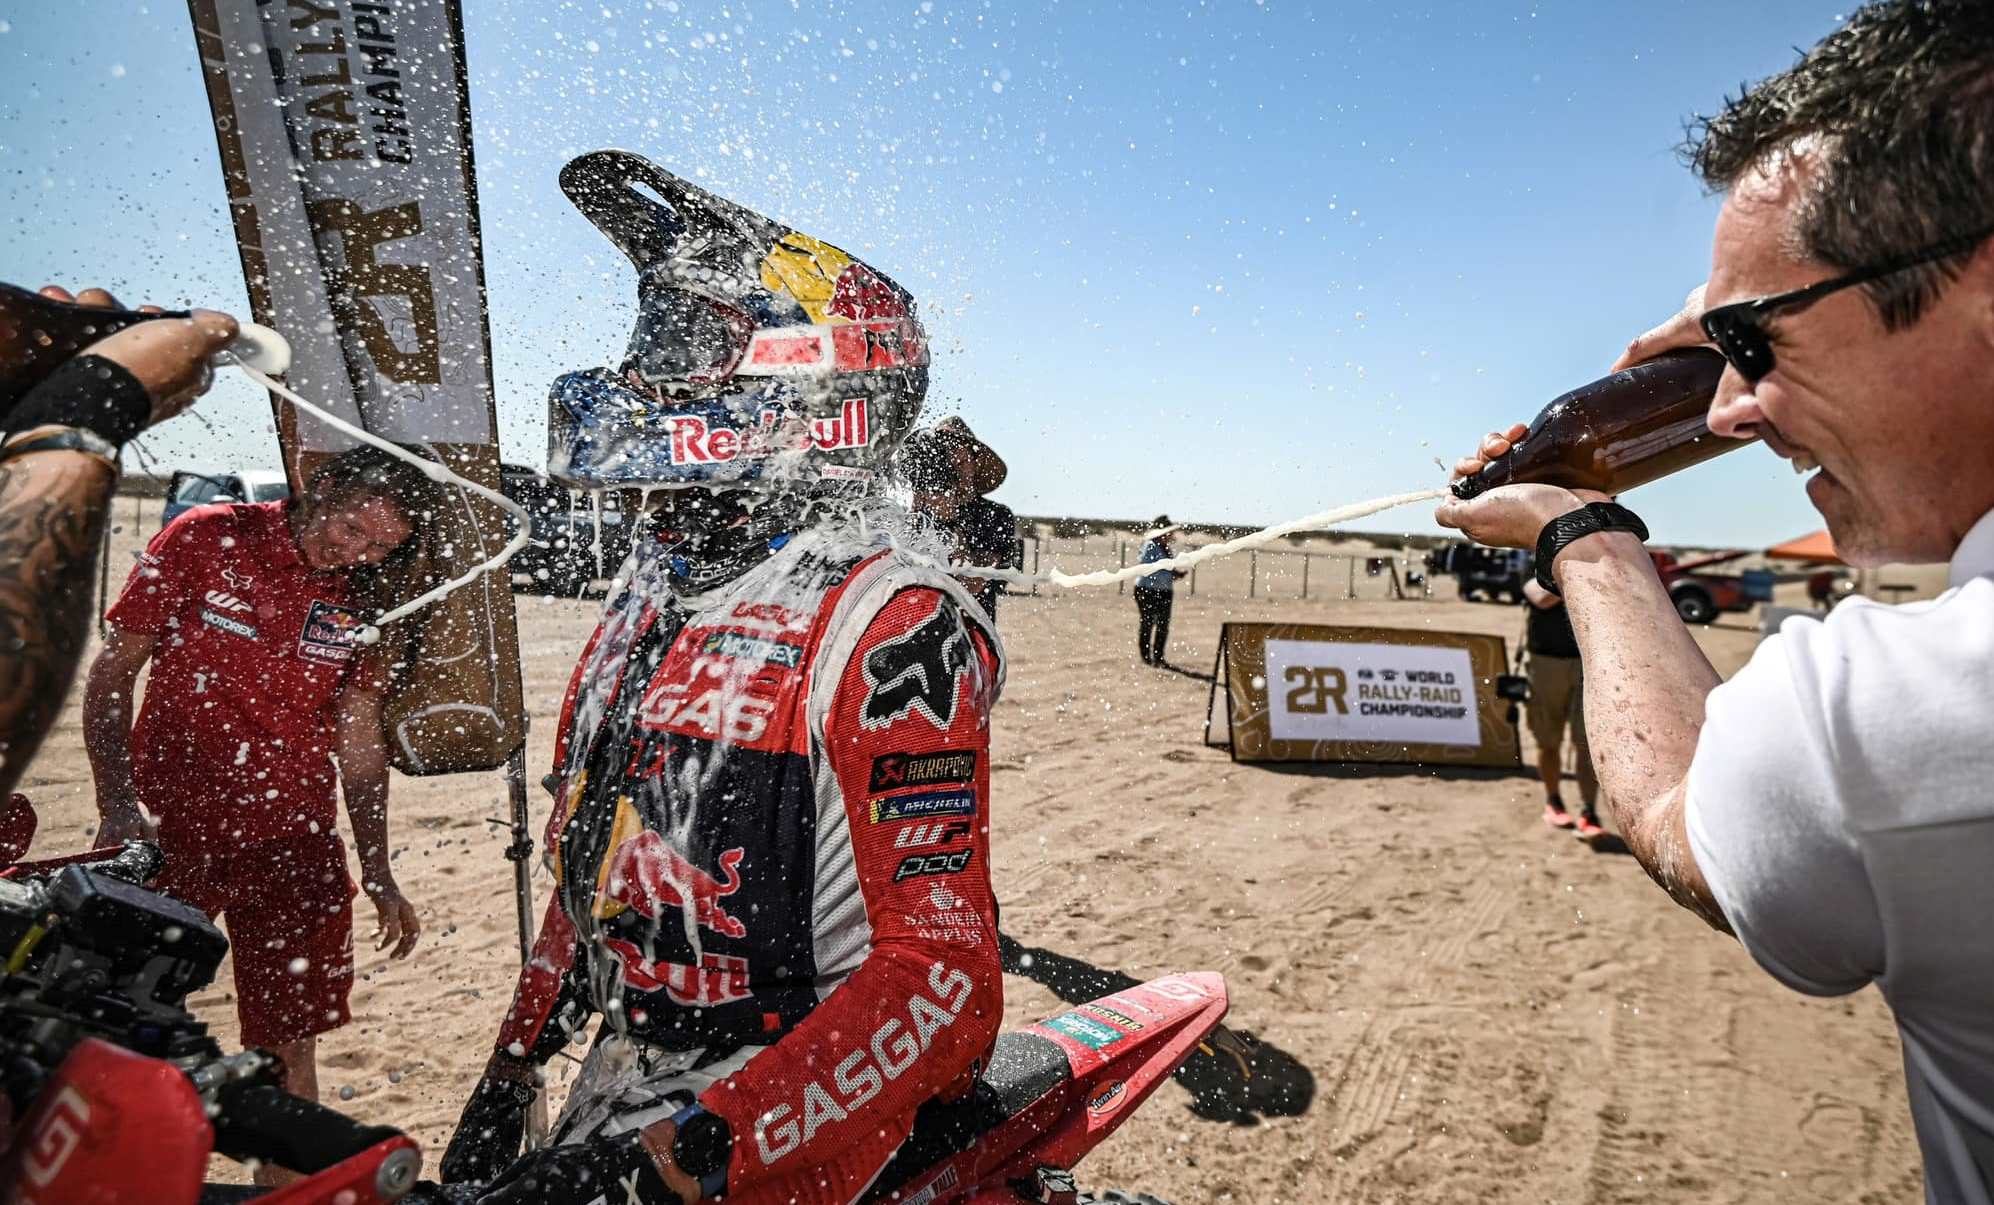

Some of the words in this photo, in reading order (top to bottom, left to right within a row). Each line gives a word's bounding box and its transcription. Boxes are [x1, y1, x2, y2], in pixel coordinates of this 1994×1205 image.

[1405, 670, 1455, 685] WORLD
[1284, 666, 1348, 714] 2R
[1358, 683, 1462, 704] RALLY-RAID
[1360, 702, 1467, 719] CHAMPIONSHIP
[754, 960, 974, 1165] GASGAS
